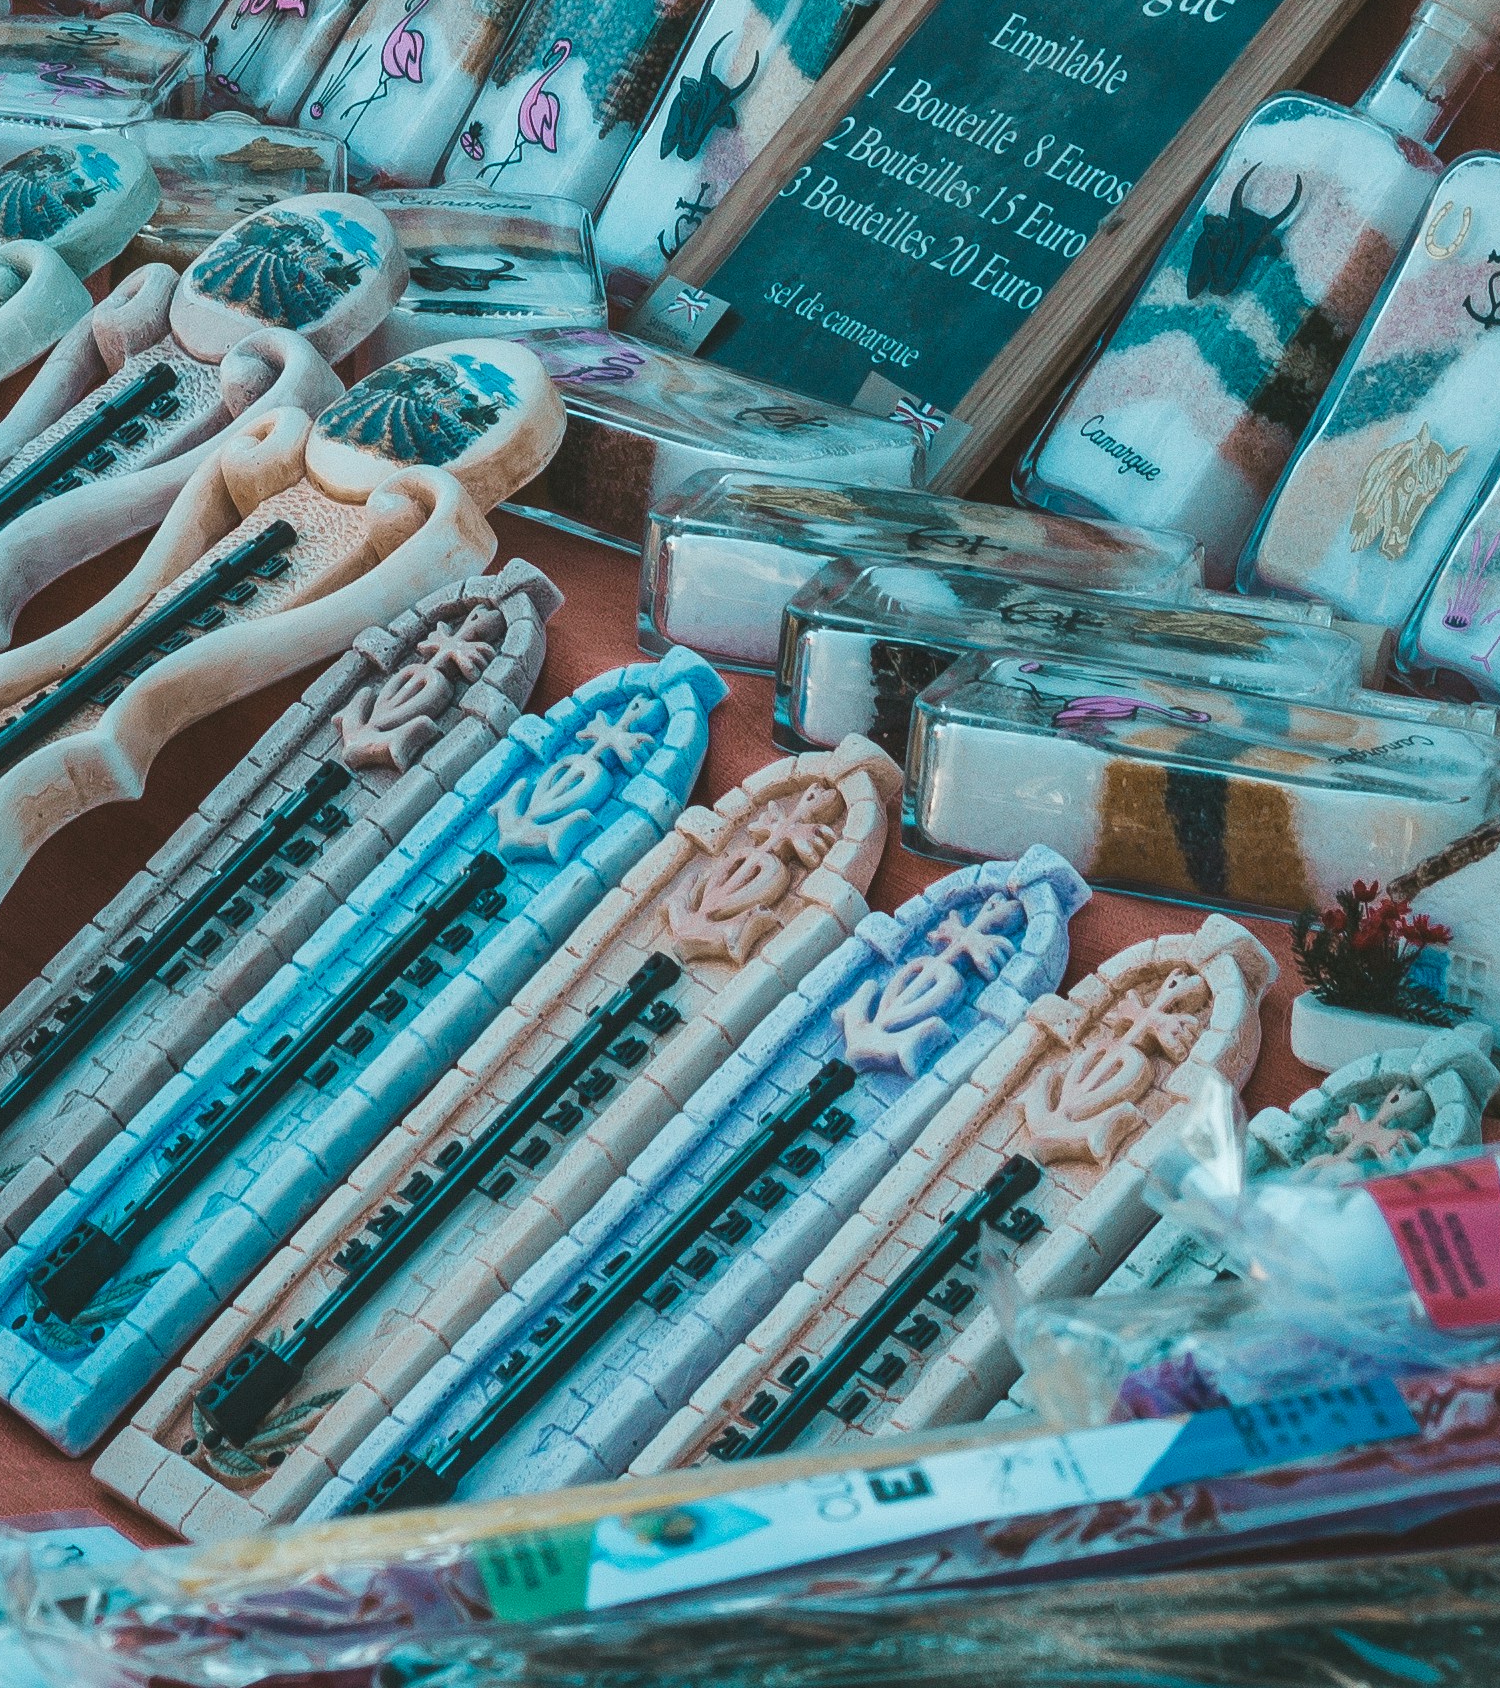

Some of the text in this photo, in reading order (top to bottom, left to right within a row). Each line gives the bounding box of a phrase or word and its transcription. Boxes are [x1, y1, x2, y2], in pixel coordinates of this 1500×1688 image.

[990, 13, 1128, 95] Empilable
[822, 117, 856, 151] 2
[847, 126, 980, 208] Bouteilles
[979, 186, 1028, 226] 15
[867, 67, 1132, 205] 1 Bouteille 8 Euros
[779, 166, 812, 197] 3
[803, 176, 936, 261] Bouteilles
[930, 236, 980, 277] 20
[764, 280, 921, 368] sel de camargue
[1080, 414, 1162, 481] Camargue
